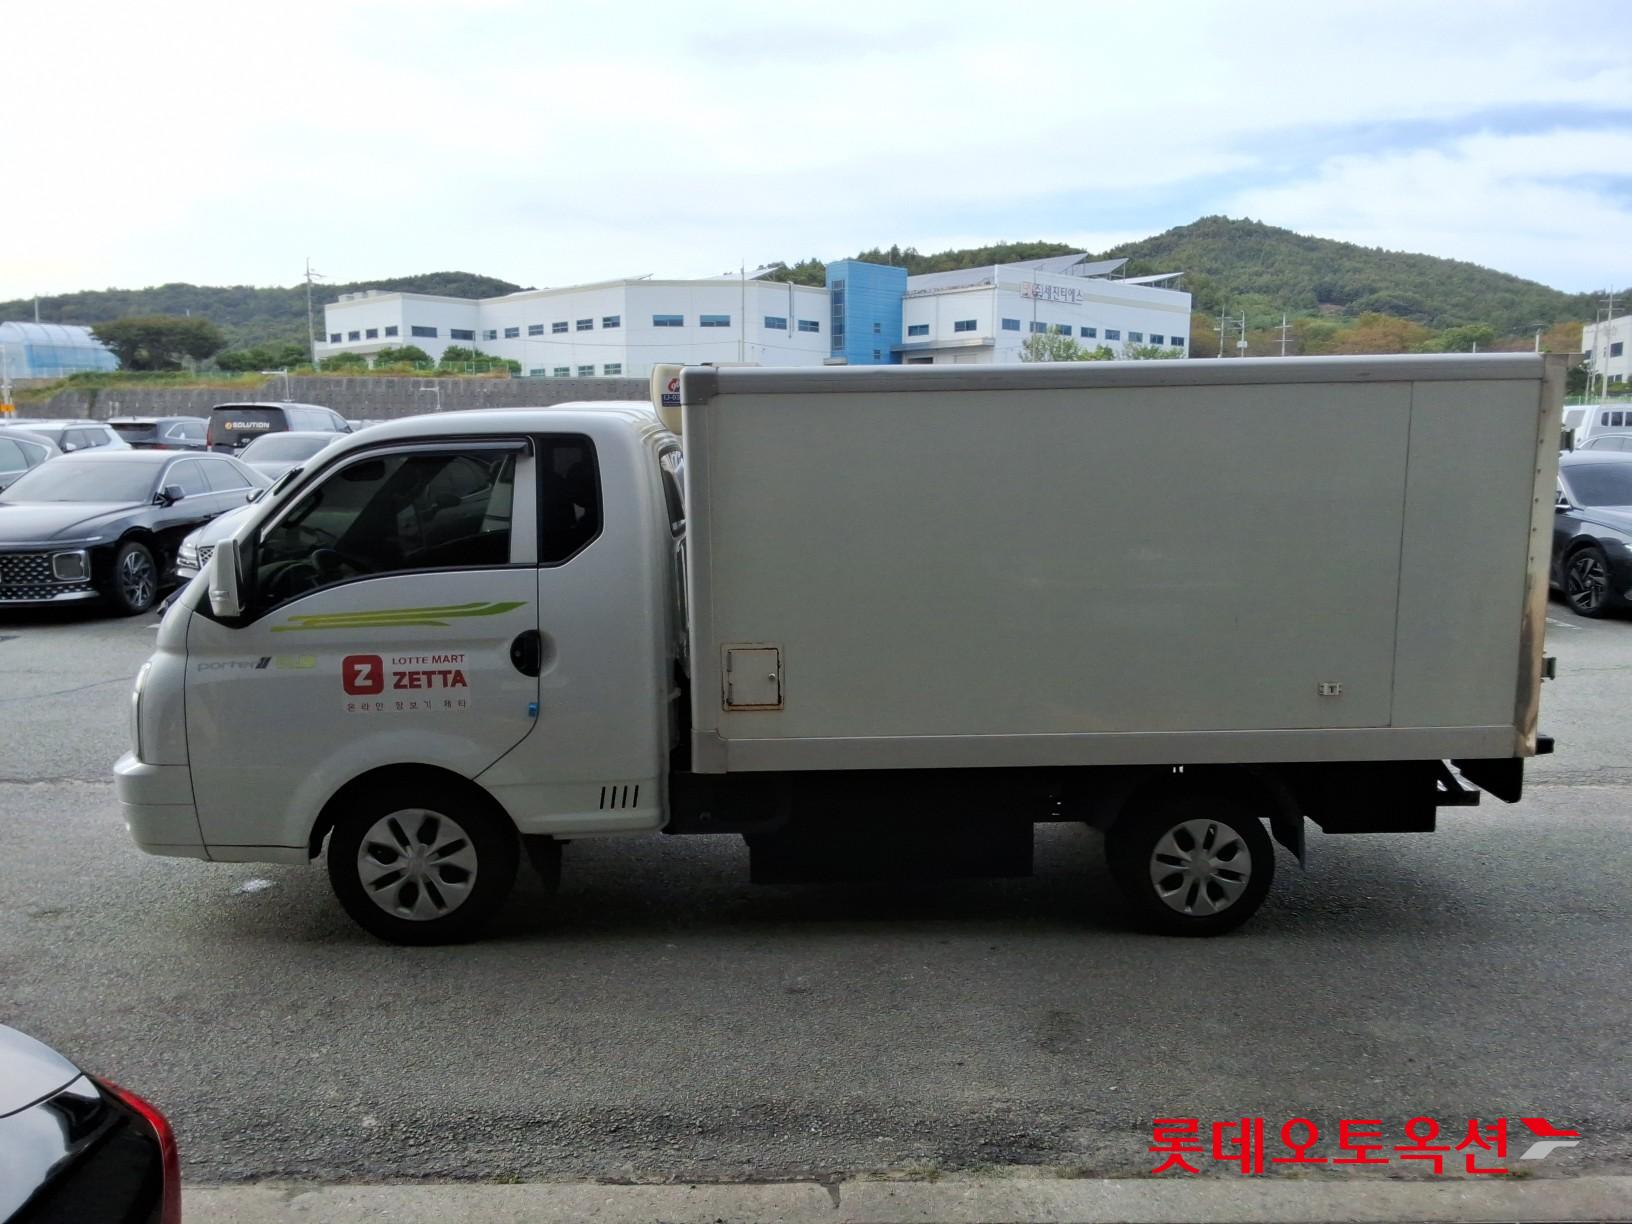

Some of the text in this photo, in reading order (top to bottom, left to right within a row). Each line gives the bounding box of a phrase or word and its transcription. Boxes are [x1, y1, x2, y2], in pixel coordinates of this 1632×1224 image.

[392, 654, 465, 665] LOTTE MART
[353, 664, 373, 687] Z
[392, 669, 468, 690] ZETTA
[347, 702, 384, 713] 온라인
